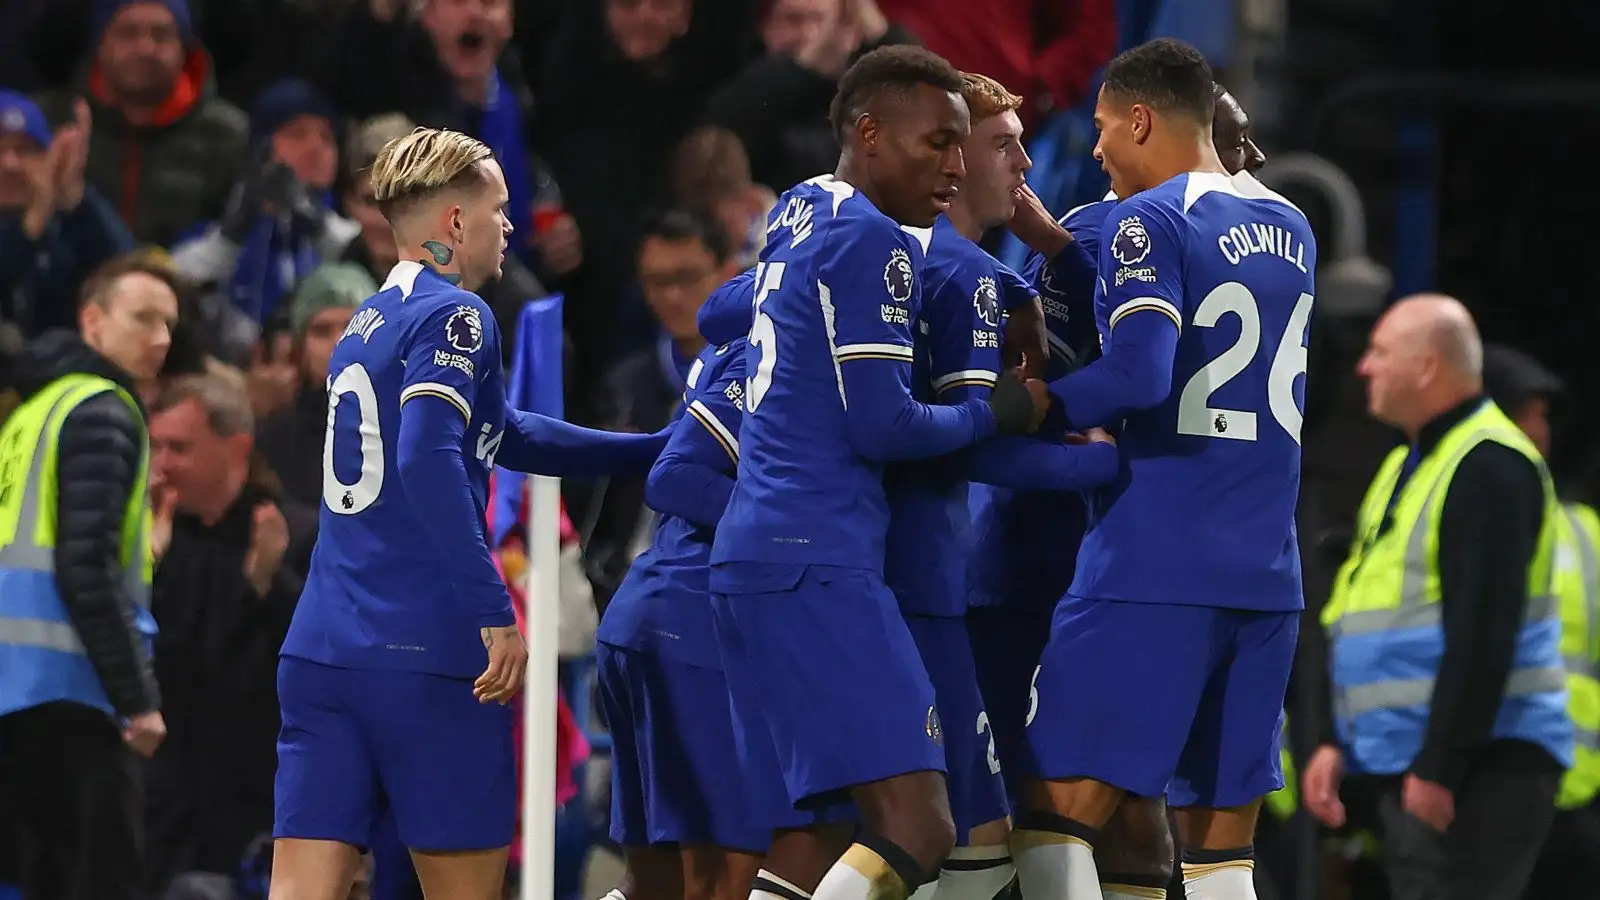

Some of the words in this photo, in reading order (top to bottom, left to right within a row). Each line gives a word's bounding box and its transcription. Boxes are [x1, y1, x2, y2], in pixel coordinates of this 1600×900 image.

[1218, 223, 1308, 274] COLWILL
[881, 304, 895, 315] No
[973, 329, 988, 340] No
[434, 349, 451, 361] No
[1177, 281, 1314, 446] 26
[322, 363, 385, 515] 0
